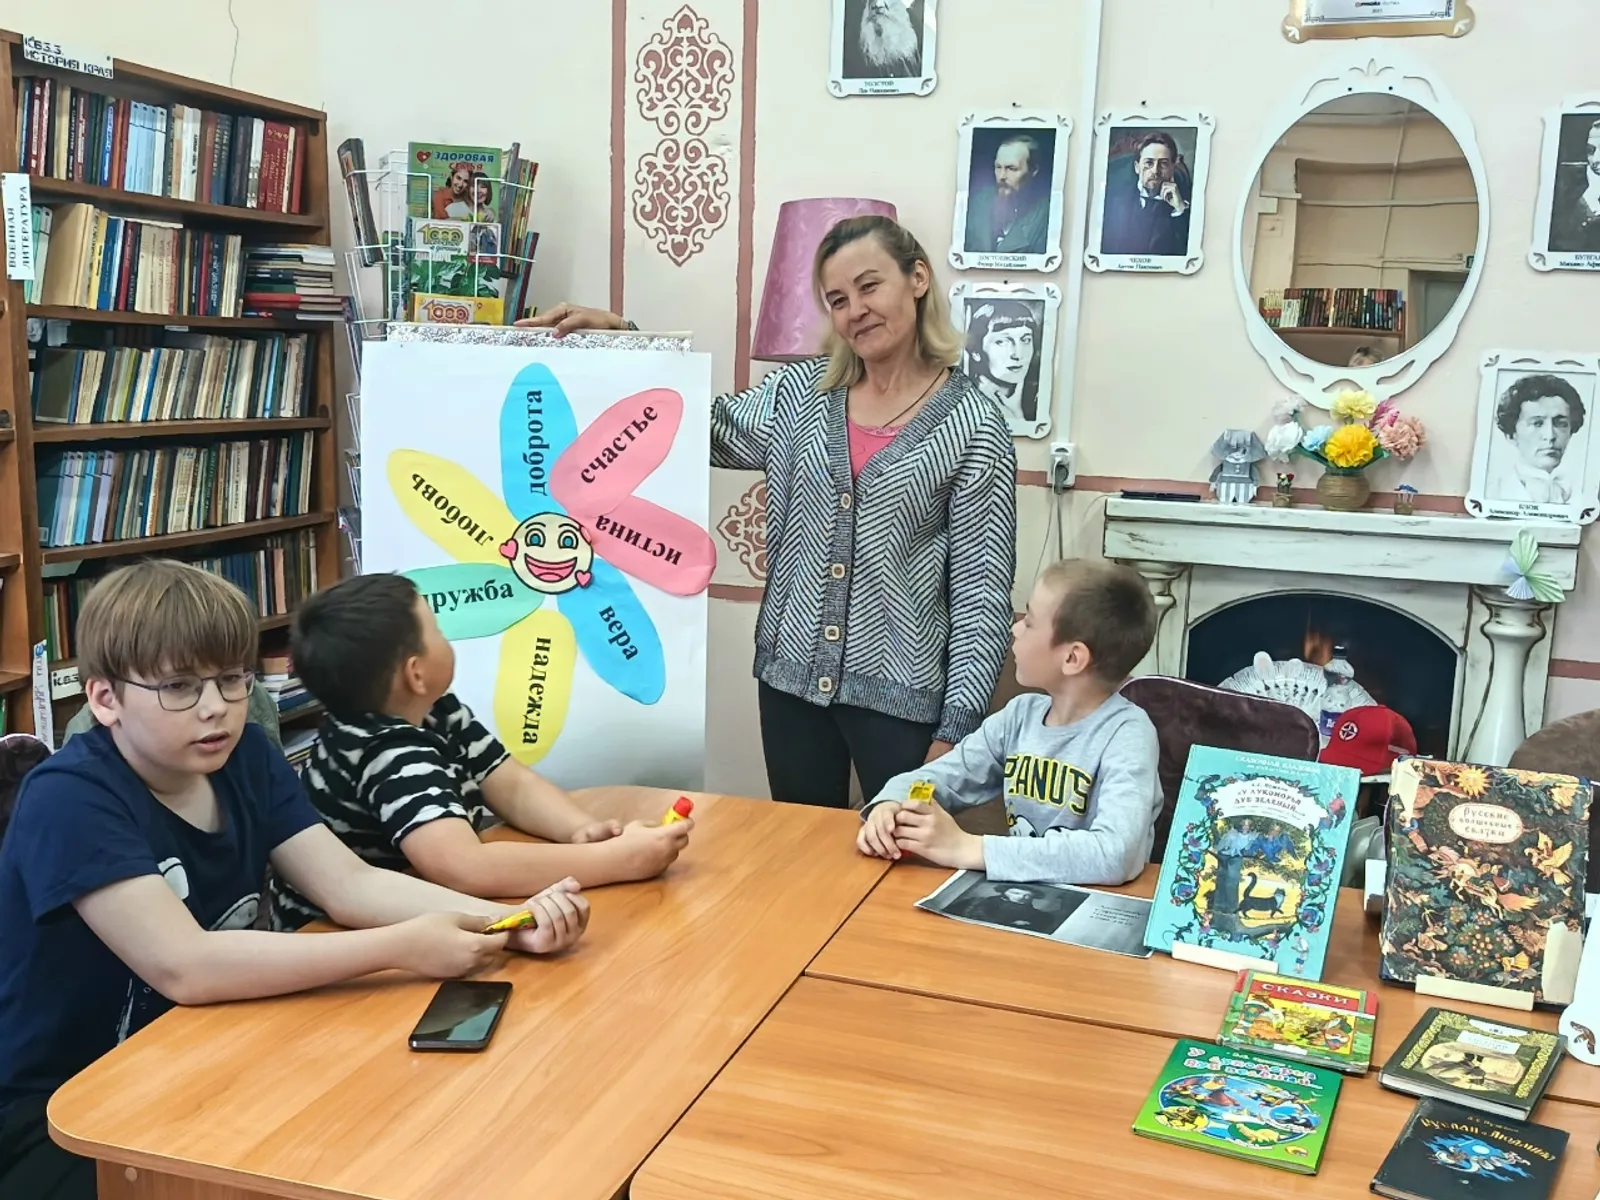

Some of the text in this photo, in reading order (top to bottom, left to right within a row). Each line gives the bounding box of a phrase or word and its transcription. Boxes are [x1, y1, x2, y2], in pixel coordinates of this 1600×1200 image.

[25, 49, 112, 78] ИСТОРИЯ КРАЯ
[434, 152, 494, 163] ЗДОРОВАЯ
[7, 207, 17, 268] ВОЕННАЯ
[19, 186, 31, 269] ЛИТЕРАТУРА
[523, 389, 550, 496] доброта
[581, 405, 659, 484] счастье
[411, 472, 494, 546] любовь
[596, 515, 683, 566] истина
[599, 605, 639, 661] вера
[523, 636, 552, 745] надежда
[1250, 789, 1302, 805] ЛУКОМОРЬЯ
[1261, 983, 1349, 1005] СКАЗКИ
